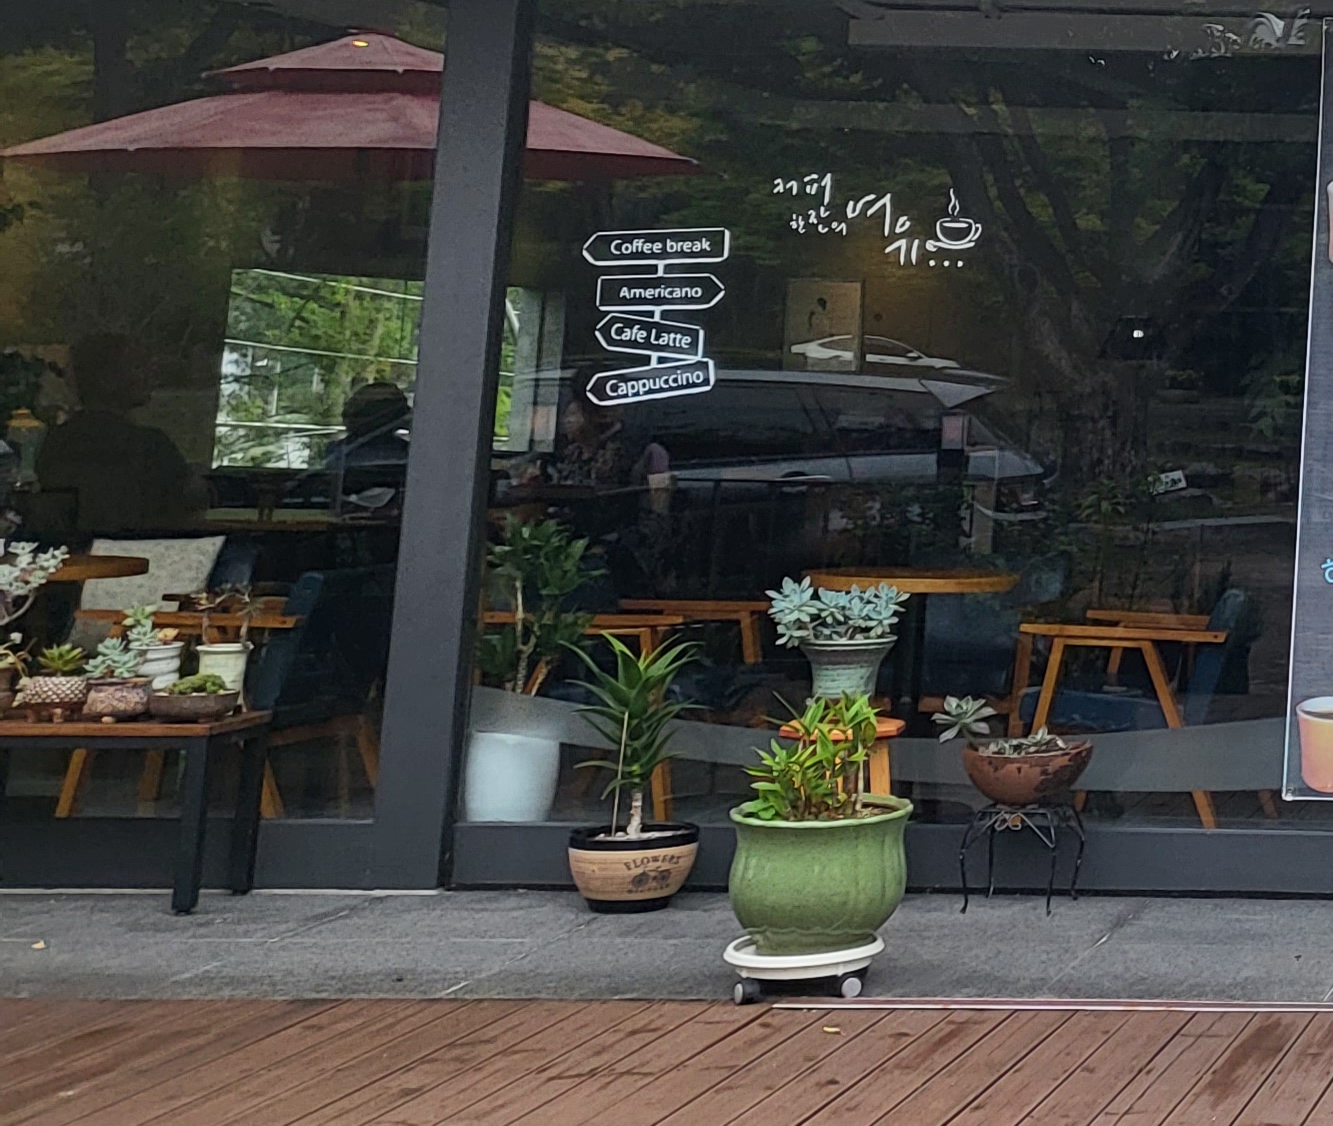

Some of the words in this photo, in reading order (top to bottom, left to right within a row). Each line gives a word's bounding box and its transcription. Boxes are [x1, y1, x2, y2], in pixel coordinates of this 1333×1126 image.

[610, 238, 662, 255] Coffee
[666, 237, 711, 253] break
[619, 284, 702, 299] Americano
[610, 324, 647, 344] Cafe
[650, 327, 692, 349] Latte
[605, 370, 704, 398] Cappuccino
